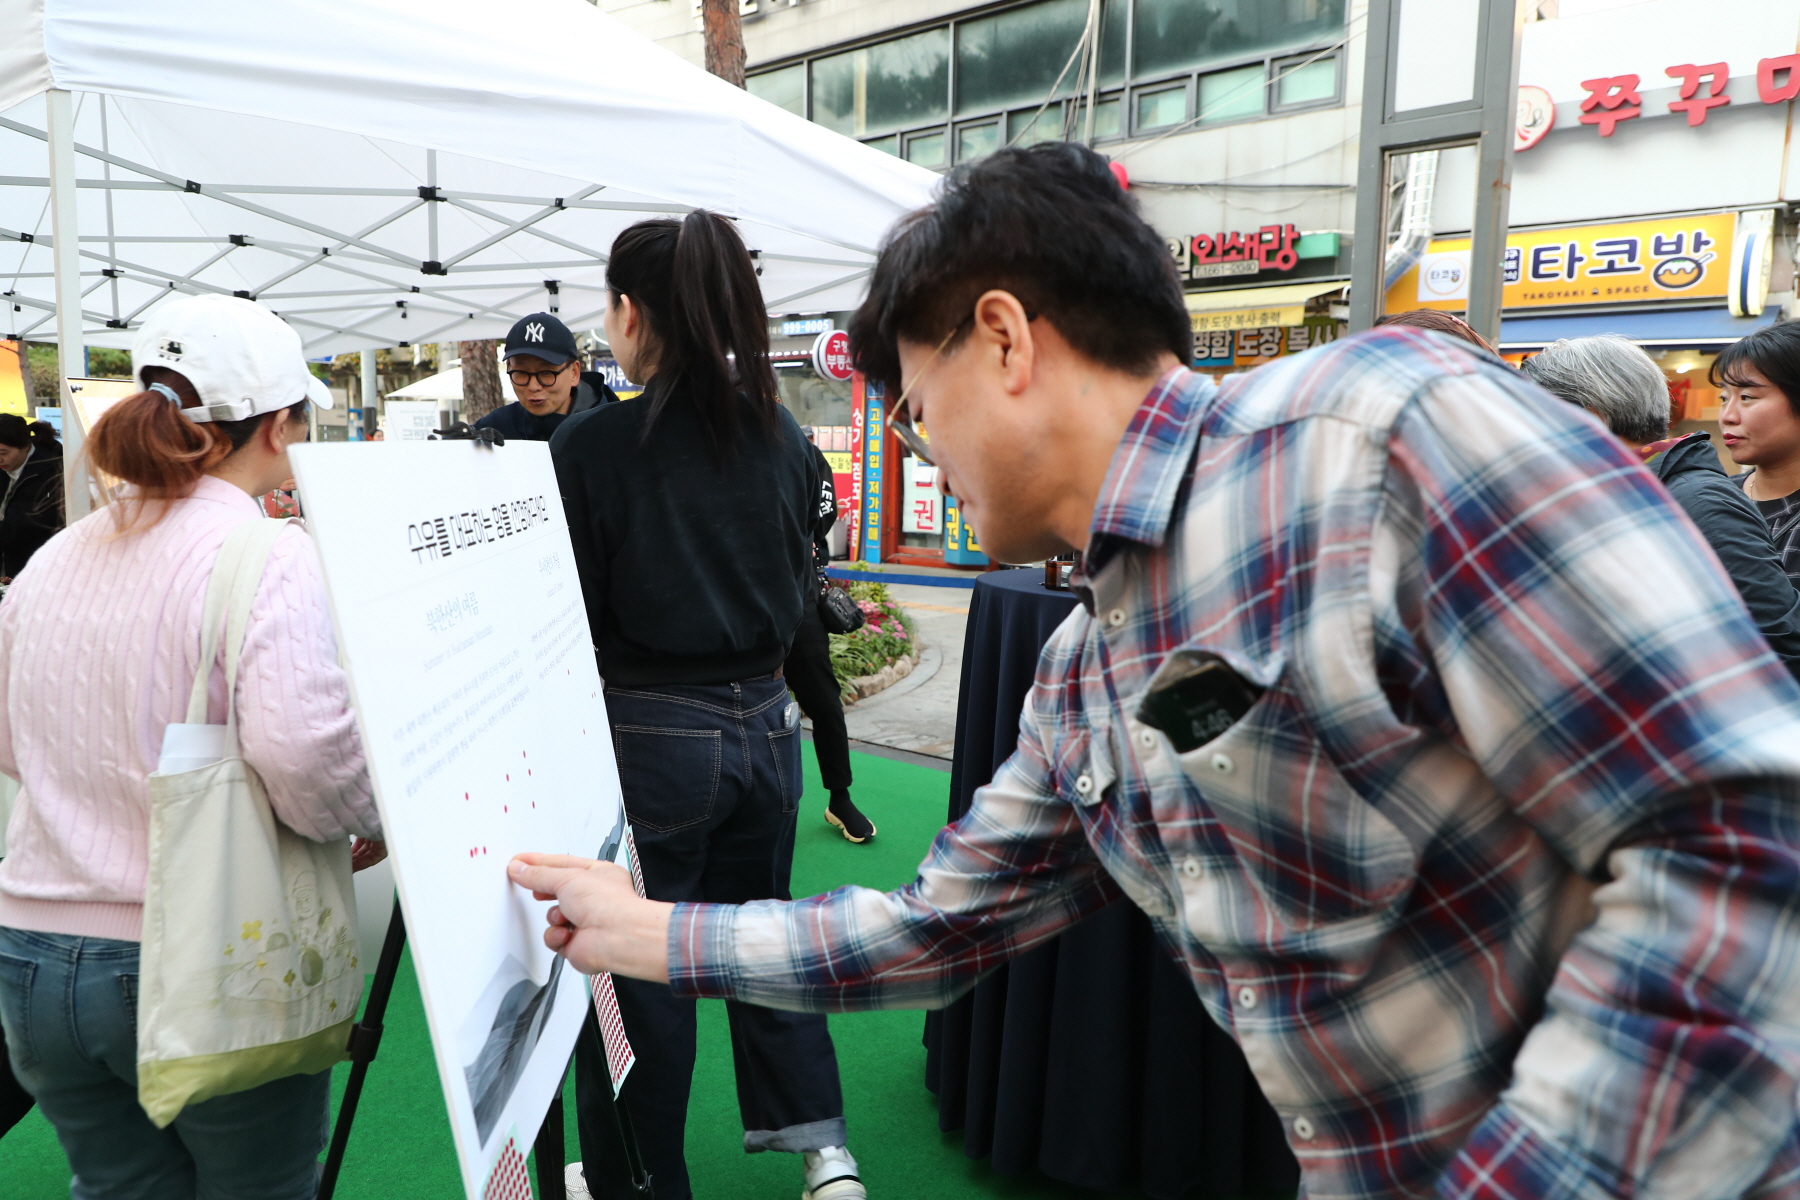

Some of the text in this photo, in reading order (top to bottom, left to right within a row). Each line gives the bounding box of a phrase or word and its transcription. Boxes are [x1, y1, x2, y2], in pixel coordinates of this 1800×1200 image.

[1191, 224, 1300, 271] 인쇄랑
[1531, 231, 1712, 290] 타코방
[1523, 284, 1651, 301] TAKOYAKI SPACE
[524, 322, 546, 343] NY
[783, 319, 830, 334] 999-0005
[1193, 330, 1232, 359] 명함
[1237, 327, 1283, 357] 도장
[408, 517, 452, 564] 수유를
[449, 508, 495, 551] 대표하는
